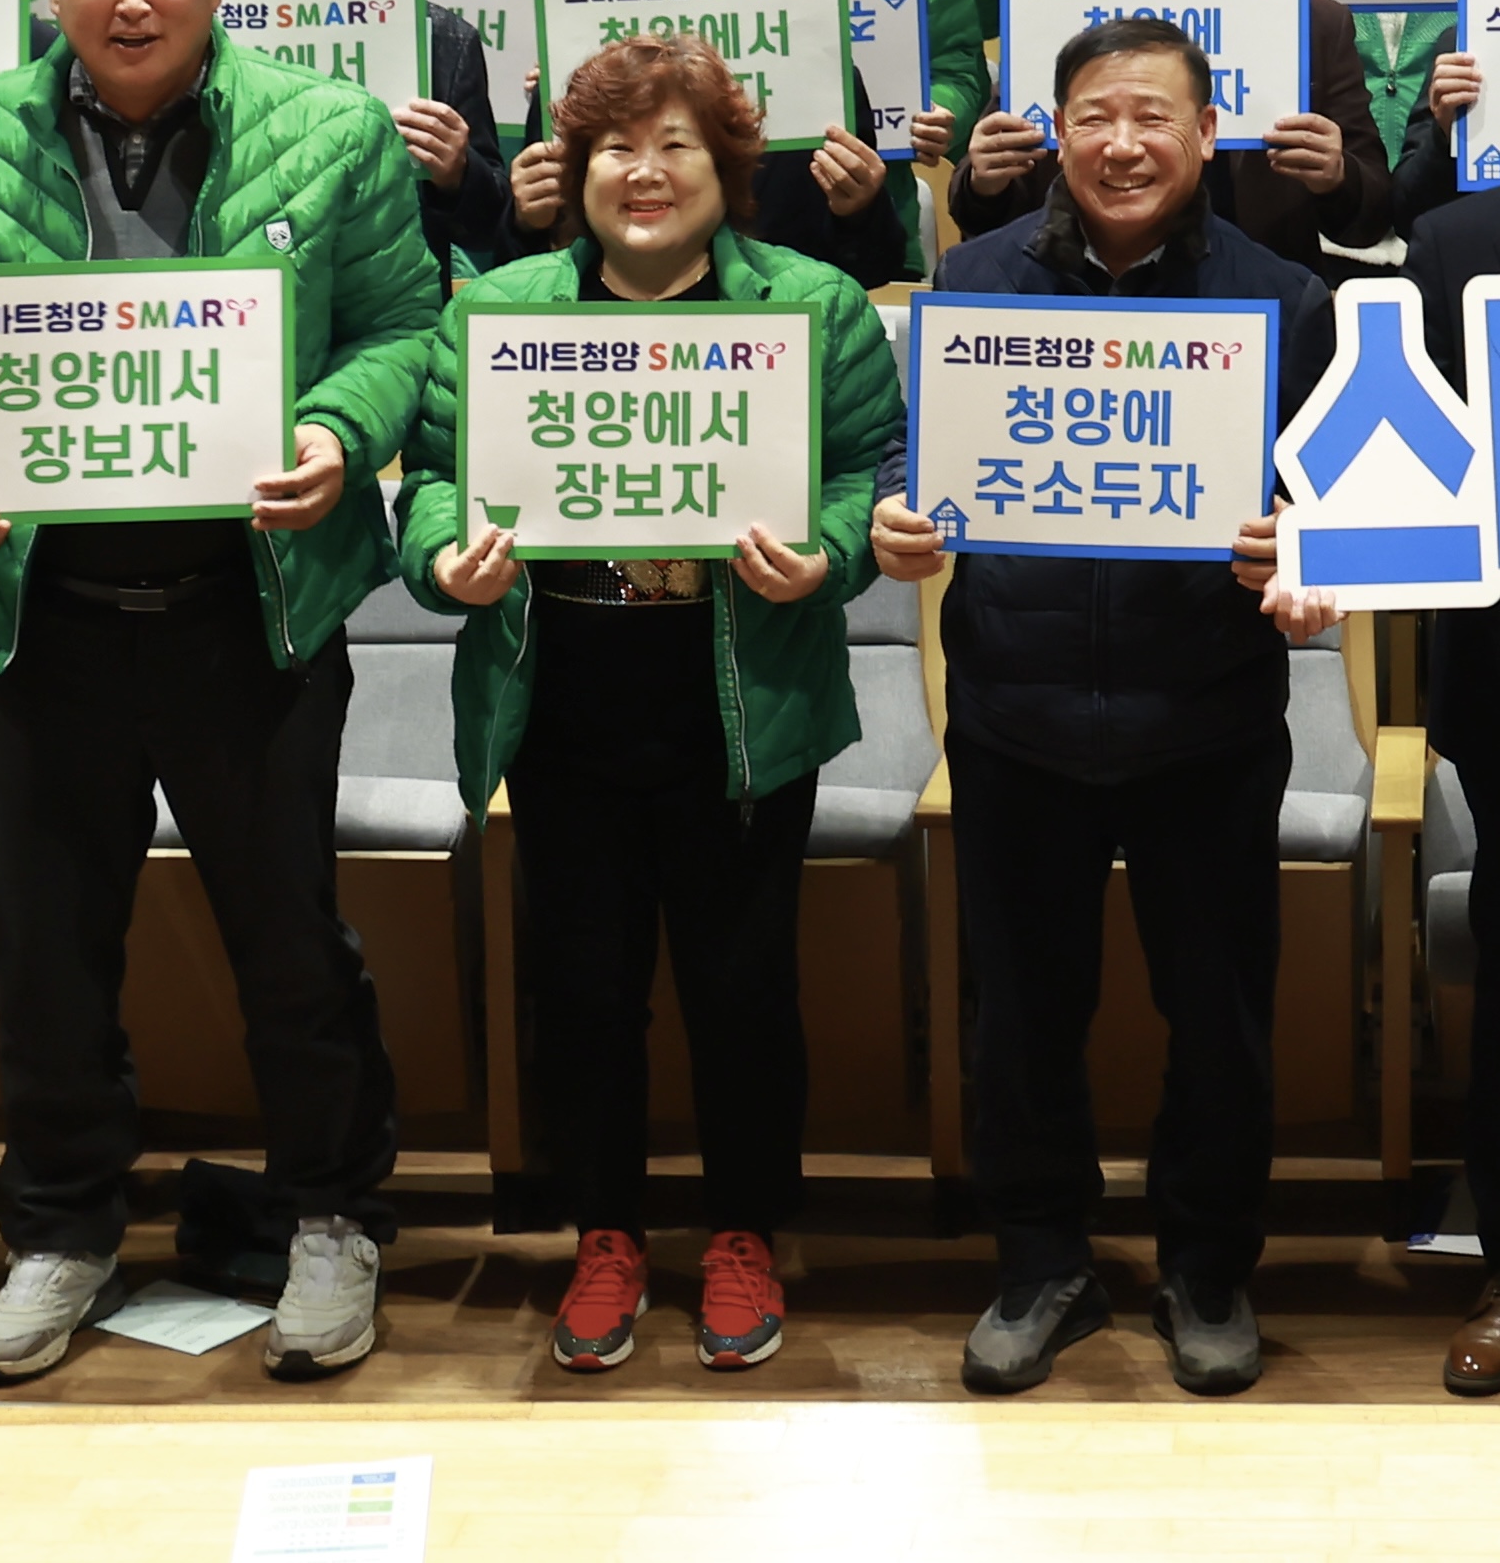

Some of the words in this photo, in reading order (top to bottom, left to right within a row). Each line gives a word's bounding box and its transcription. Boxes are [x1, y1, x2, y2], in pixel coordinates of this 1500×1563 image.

[491, 342, 640, 372] 스마트청양
[944, 335, 1094, 368] 스마트청양
[528, 390, 748, 448] 청양에서
[1006, 385, 1171, 446] 청양에
[20, 422, 197, 484] 장보자
[555, 463, 726, 520] 장보자
[975, 458, 1204, 520] 주소두자
